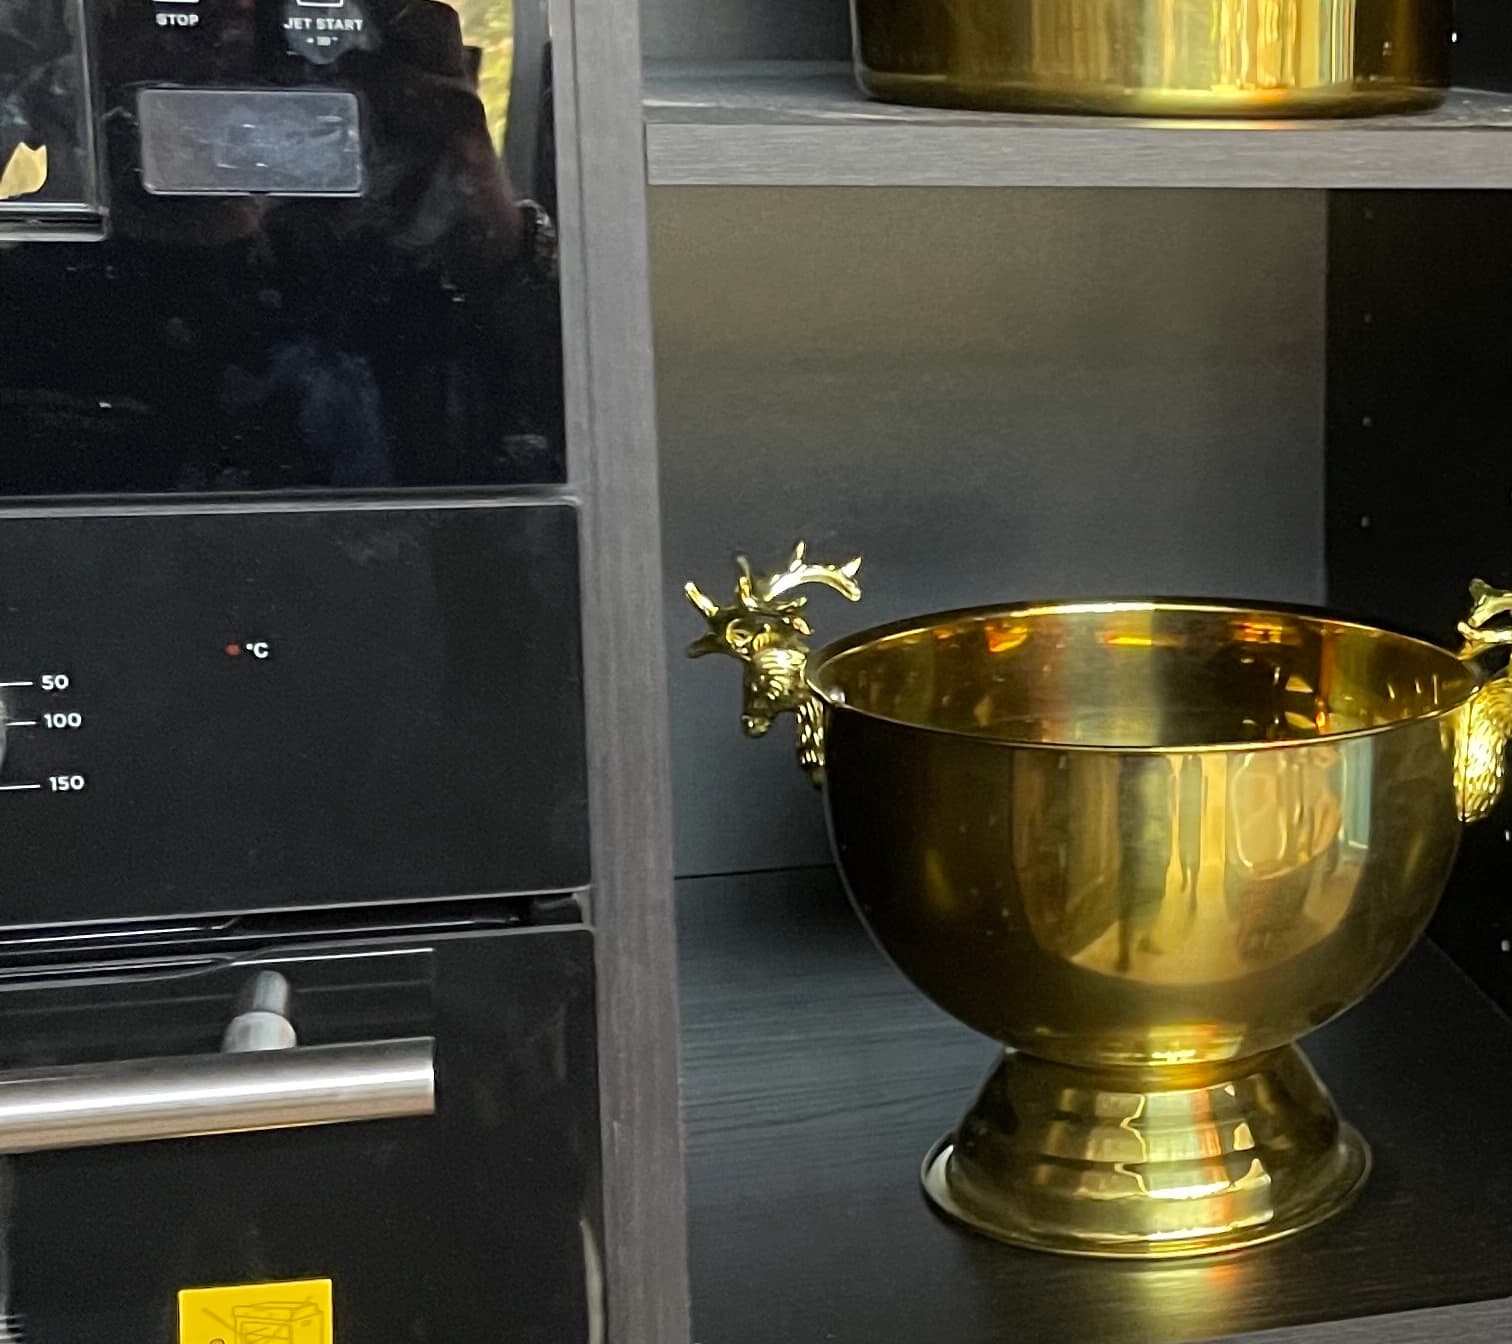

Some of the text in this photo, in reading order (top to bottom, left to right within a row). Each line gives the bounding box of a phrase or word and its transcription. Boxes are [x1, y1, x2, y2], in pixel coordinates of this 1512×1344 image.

[155, 13, 199, 26] STOP
[283, 18, 363, 31] JET START
[246, 642, 269, 658] °C
[41, 674, 69, 690] 50
[44, 712, 82, 728] 100
[49, 775, 85, 792] 150
